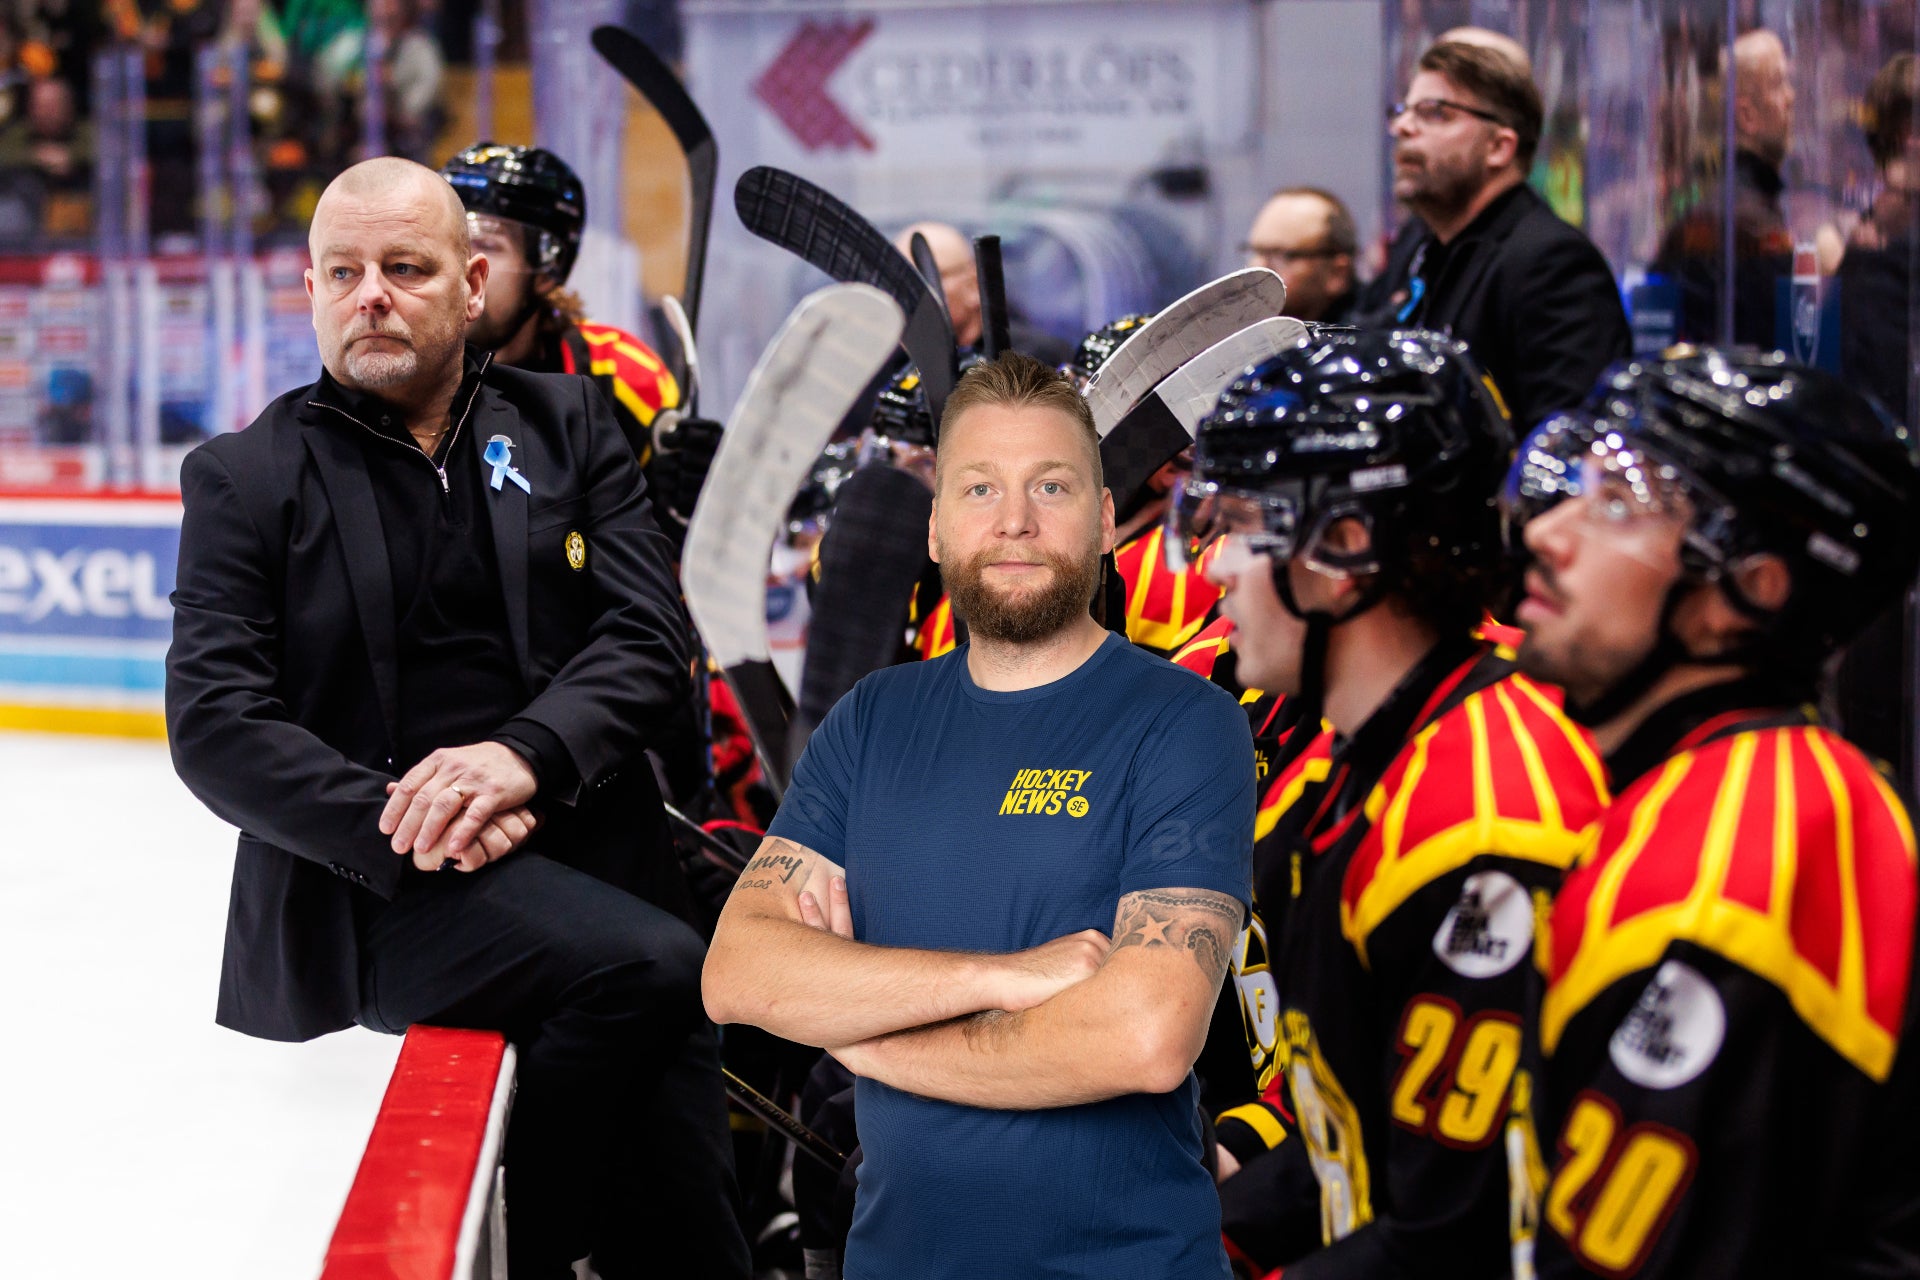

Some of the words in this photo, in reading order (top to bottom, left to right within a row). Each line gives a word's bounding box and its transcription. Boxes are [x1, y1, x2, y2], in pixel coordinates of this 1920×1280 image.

[998, 789, 1067, 816] NEWS
[1070, 800, 1085, 813] SE
[1010, 768, 1093, 792] HOCKEY
[1392, 1000, 1522, 1144] 29
[1547, 1097, 1690, 1273] 20
